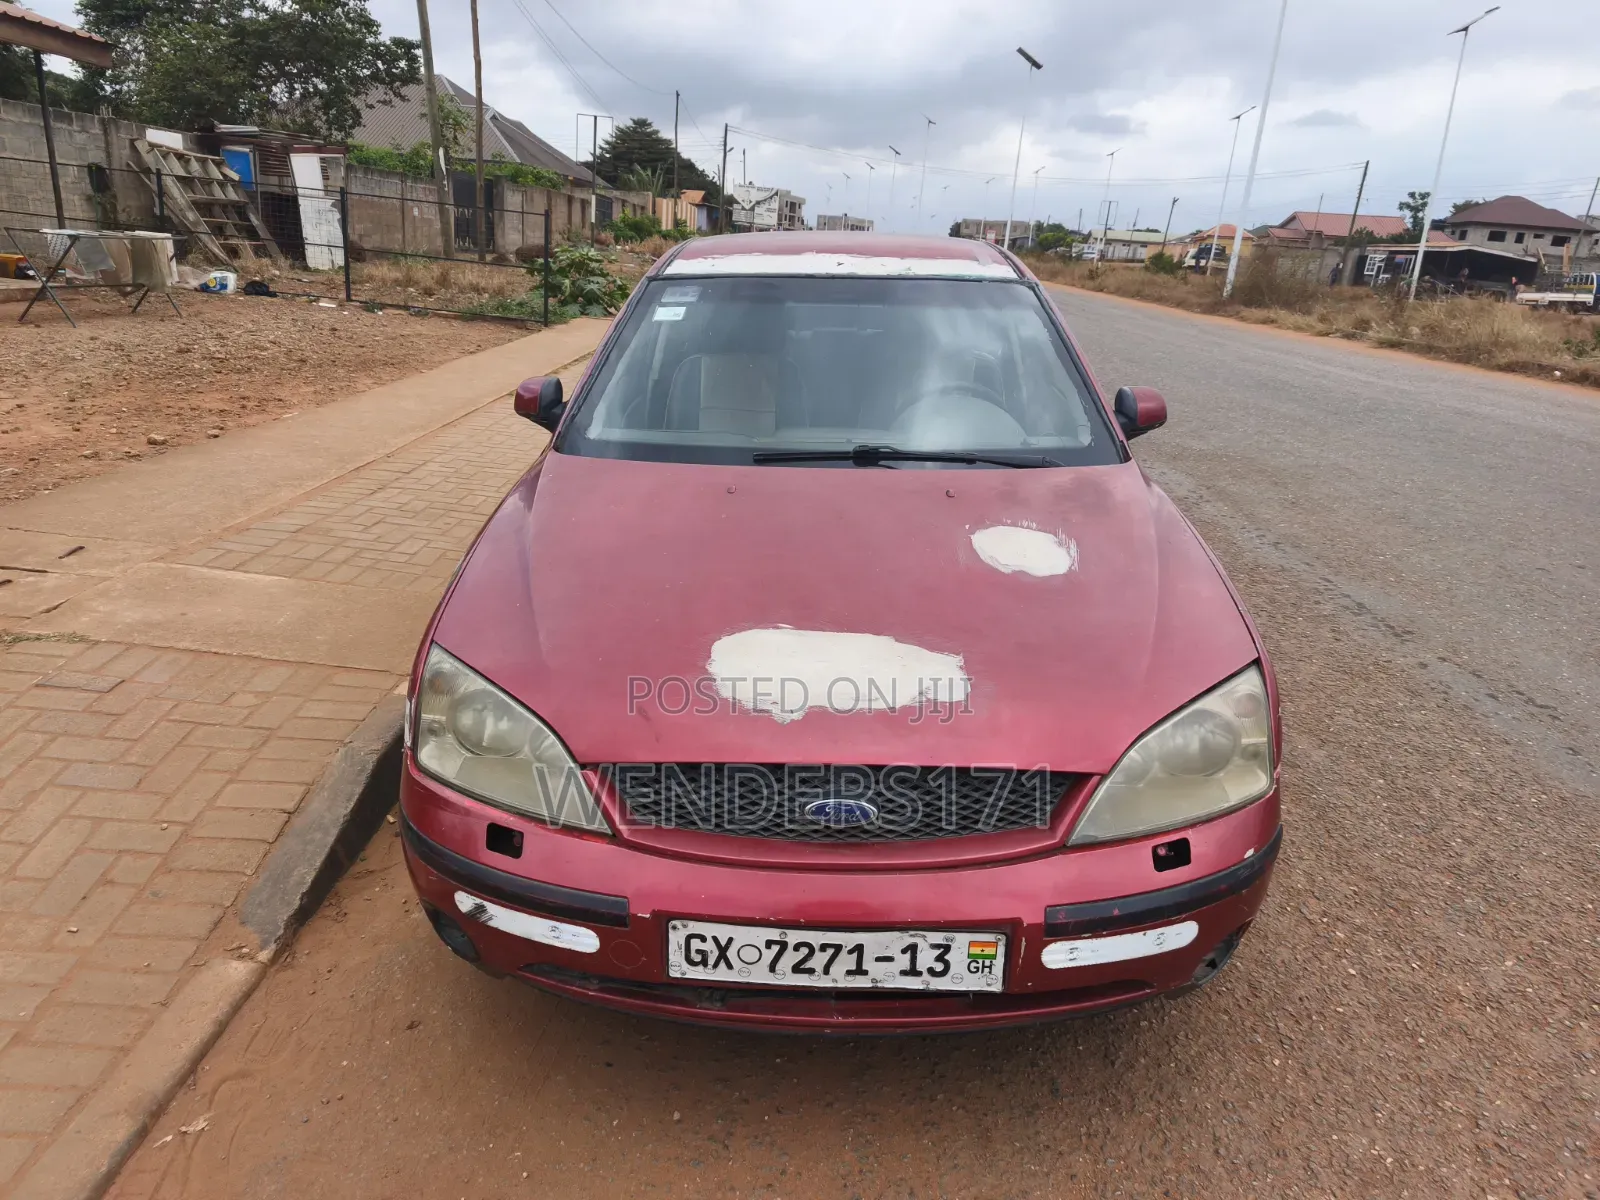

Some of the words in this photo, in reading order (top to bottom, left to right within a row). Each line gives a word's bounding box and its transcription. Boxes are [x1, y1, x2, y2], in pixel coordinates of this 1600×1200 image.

[821, 804, 861, 821] Ford
[684, 933, 734, 970] GX
[765, 939, 952, 978] 7271-13
[967, 959, 993, 974] GH
